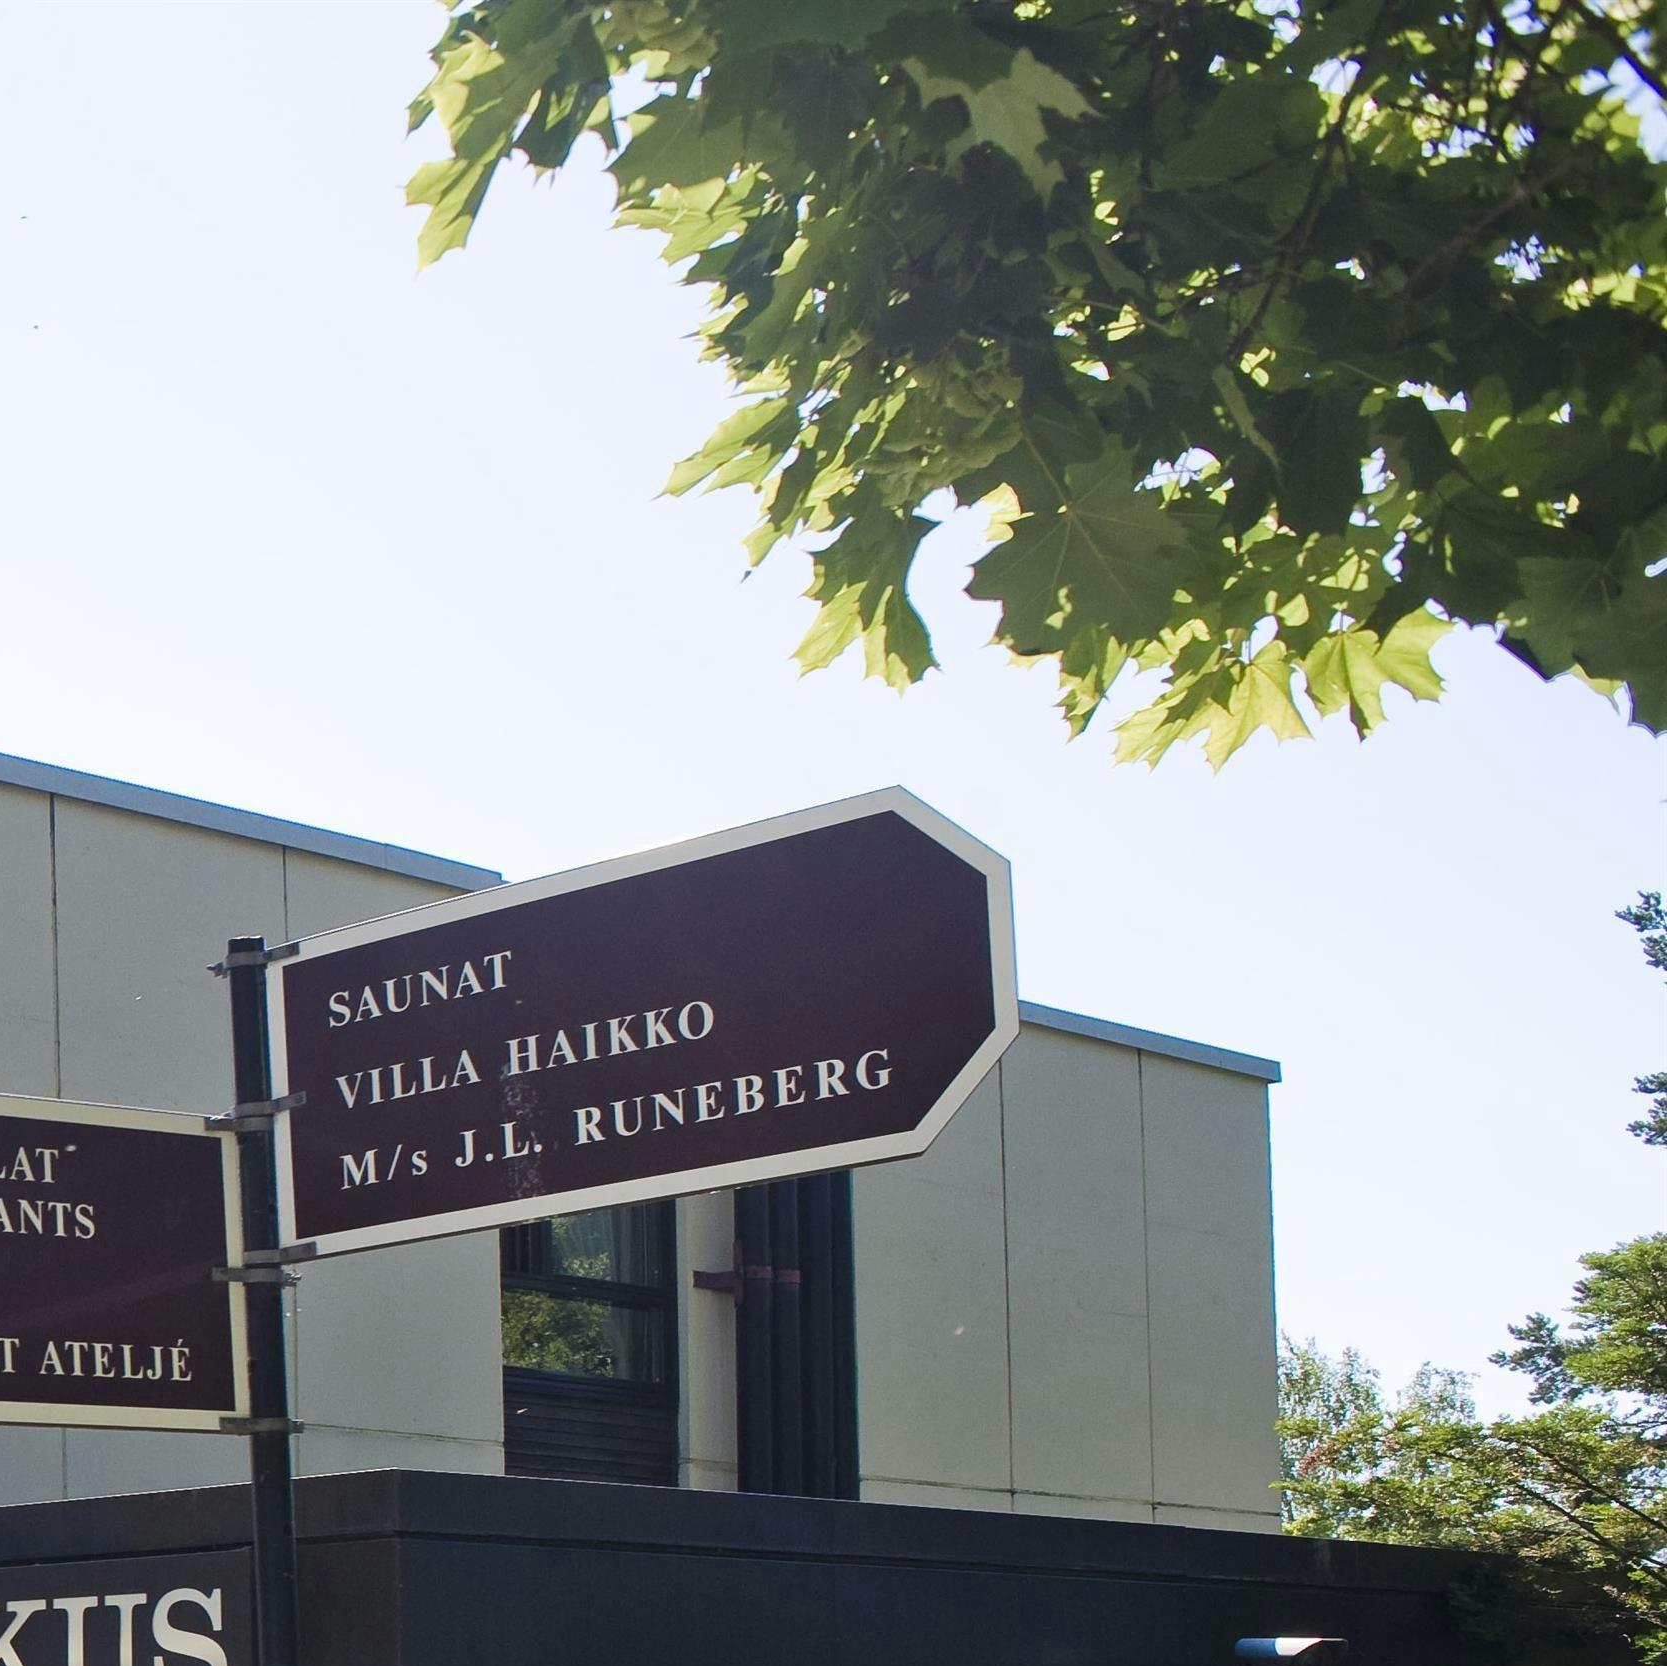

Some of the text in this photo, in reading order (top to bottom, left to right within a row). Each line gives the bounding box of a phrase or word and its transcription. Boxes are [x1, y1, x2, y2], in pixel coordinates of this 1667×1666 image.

[329, 950, 512, 1028] SAUNAT
[335, 1000, 714, 1109] VILLA HAIKKO
[339, 1048, 892, 1190] M/s J.L. RUNEBERG
[39, 1338, 192, 1382] ATELJÉ
